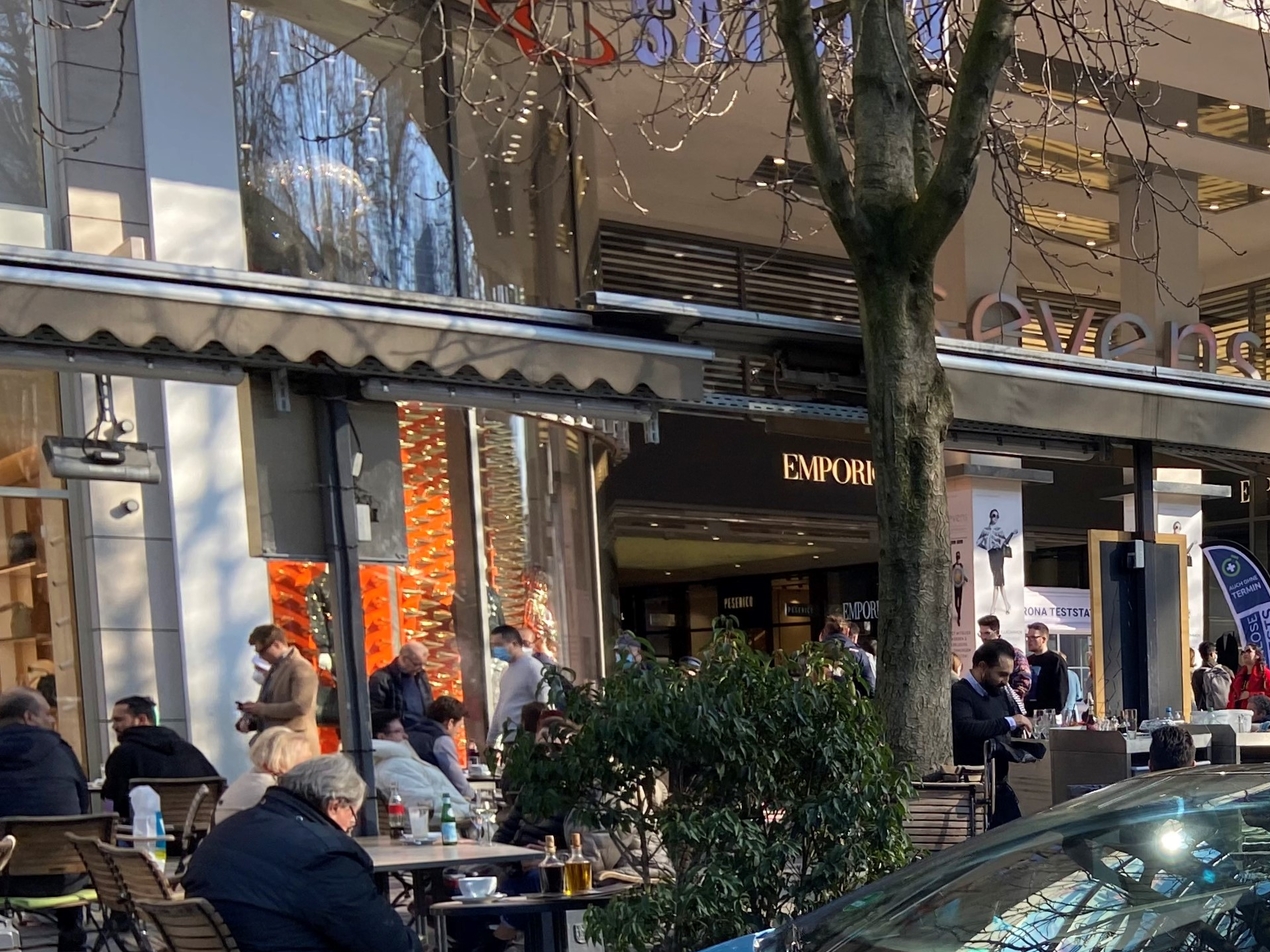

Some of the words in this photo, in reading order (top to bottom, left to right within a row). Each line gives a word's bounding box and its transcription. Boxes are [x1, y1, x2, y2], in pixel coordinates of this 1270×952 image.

[782, 453, 876, 486] EMPORI
[1229, 579, 1243, 591] AUCH
[1231, 582, 1262, 600] TERMIN
[1050, 608, 1091, 617] TESTSTA
